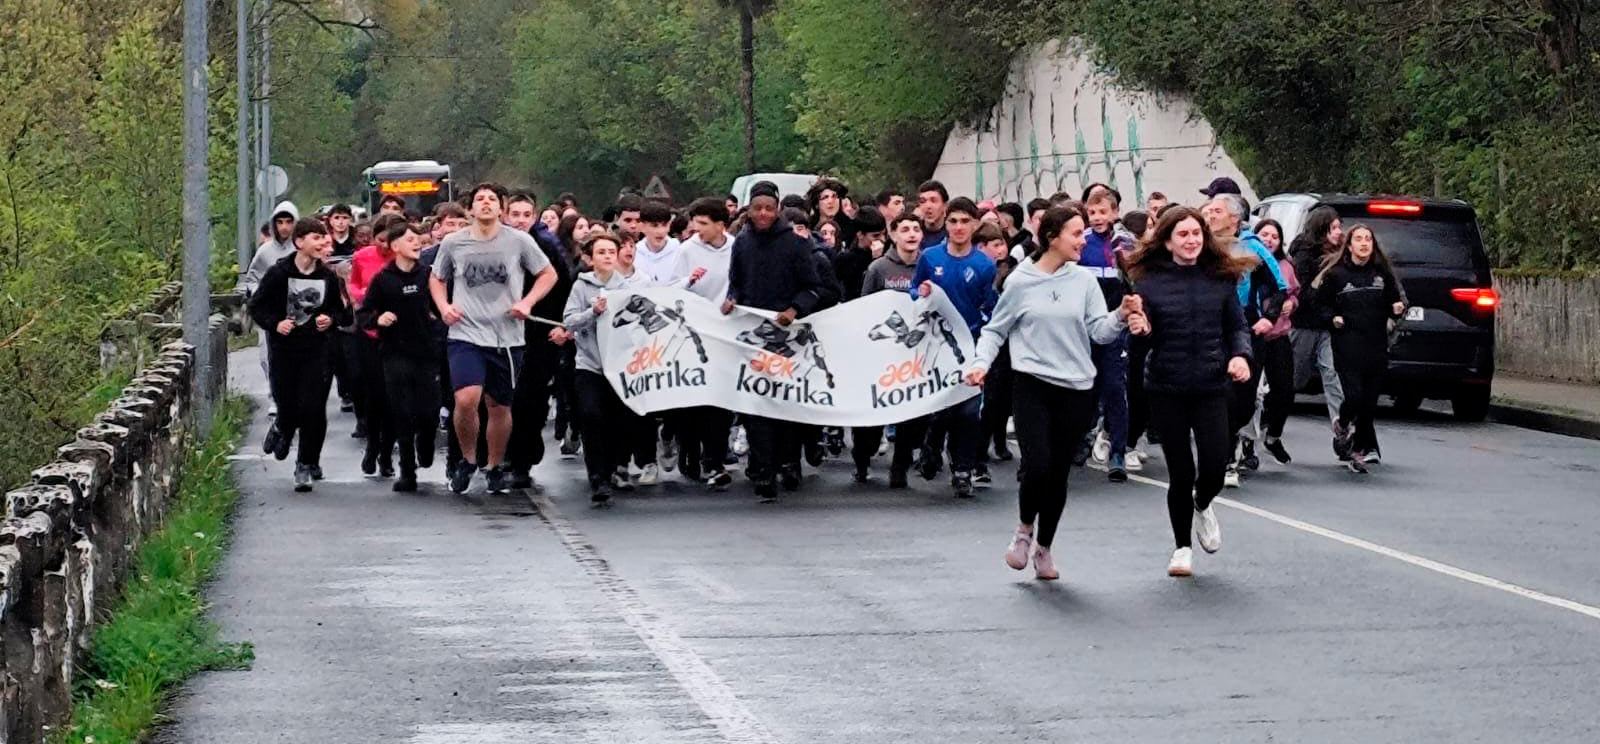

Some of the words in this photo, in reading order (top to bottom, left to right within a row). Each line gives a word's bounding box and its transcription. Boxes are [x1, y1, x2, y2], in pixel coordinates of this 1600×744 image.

[619, 360, 706, 399] korrika
[736, 364, 834, 406] korrika
[871, 367, 964, 408] korrika
[879, 348, 924, 387] aek
